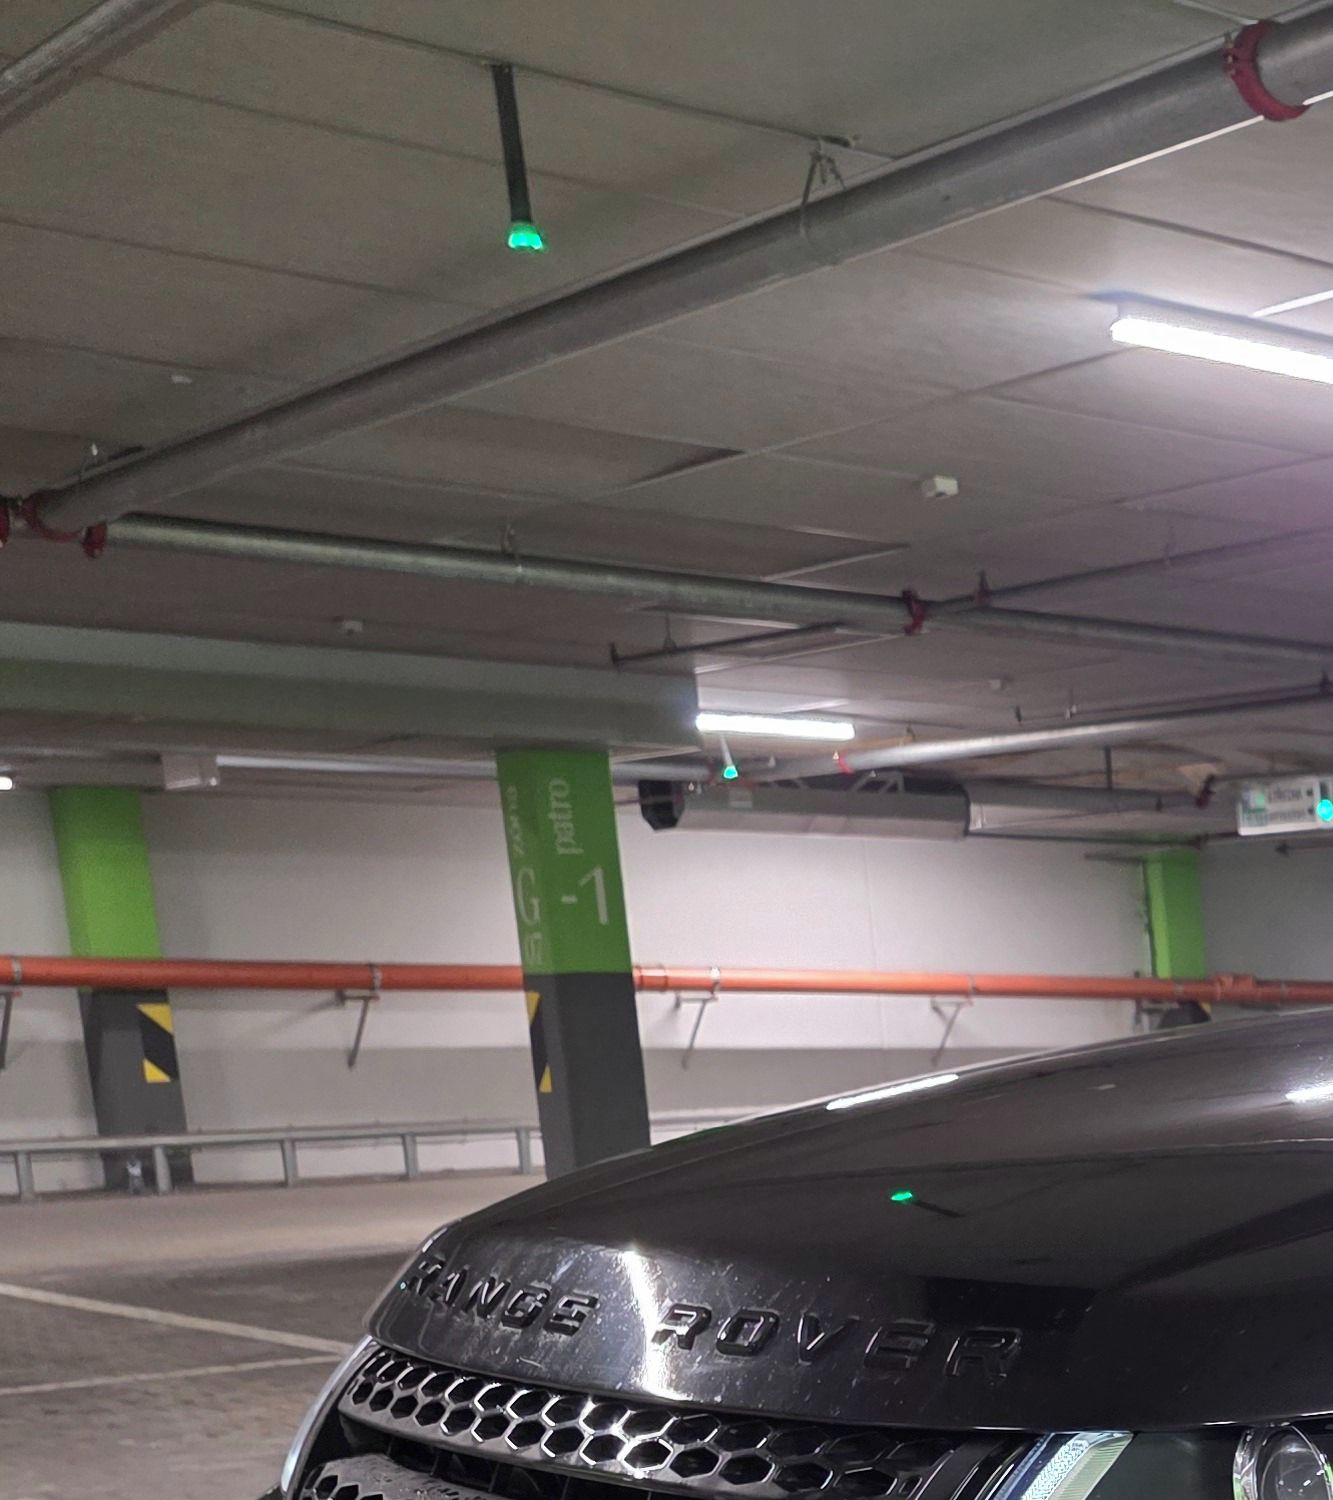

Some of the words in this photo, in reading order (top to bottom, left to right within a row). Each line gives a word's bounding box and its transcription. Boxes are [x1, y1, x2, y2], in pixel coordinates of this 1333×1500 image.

[547, 777, 584, 855] patro
[407, 1252, 600, 1338] RANGE
[651, 1300, 1022, 1378] ROVER
